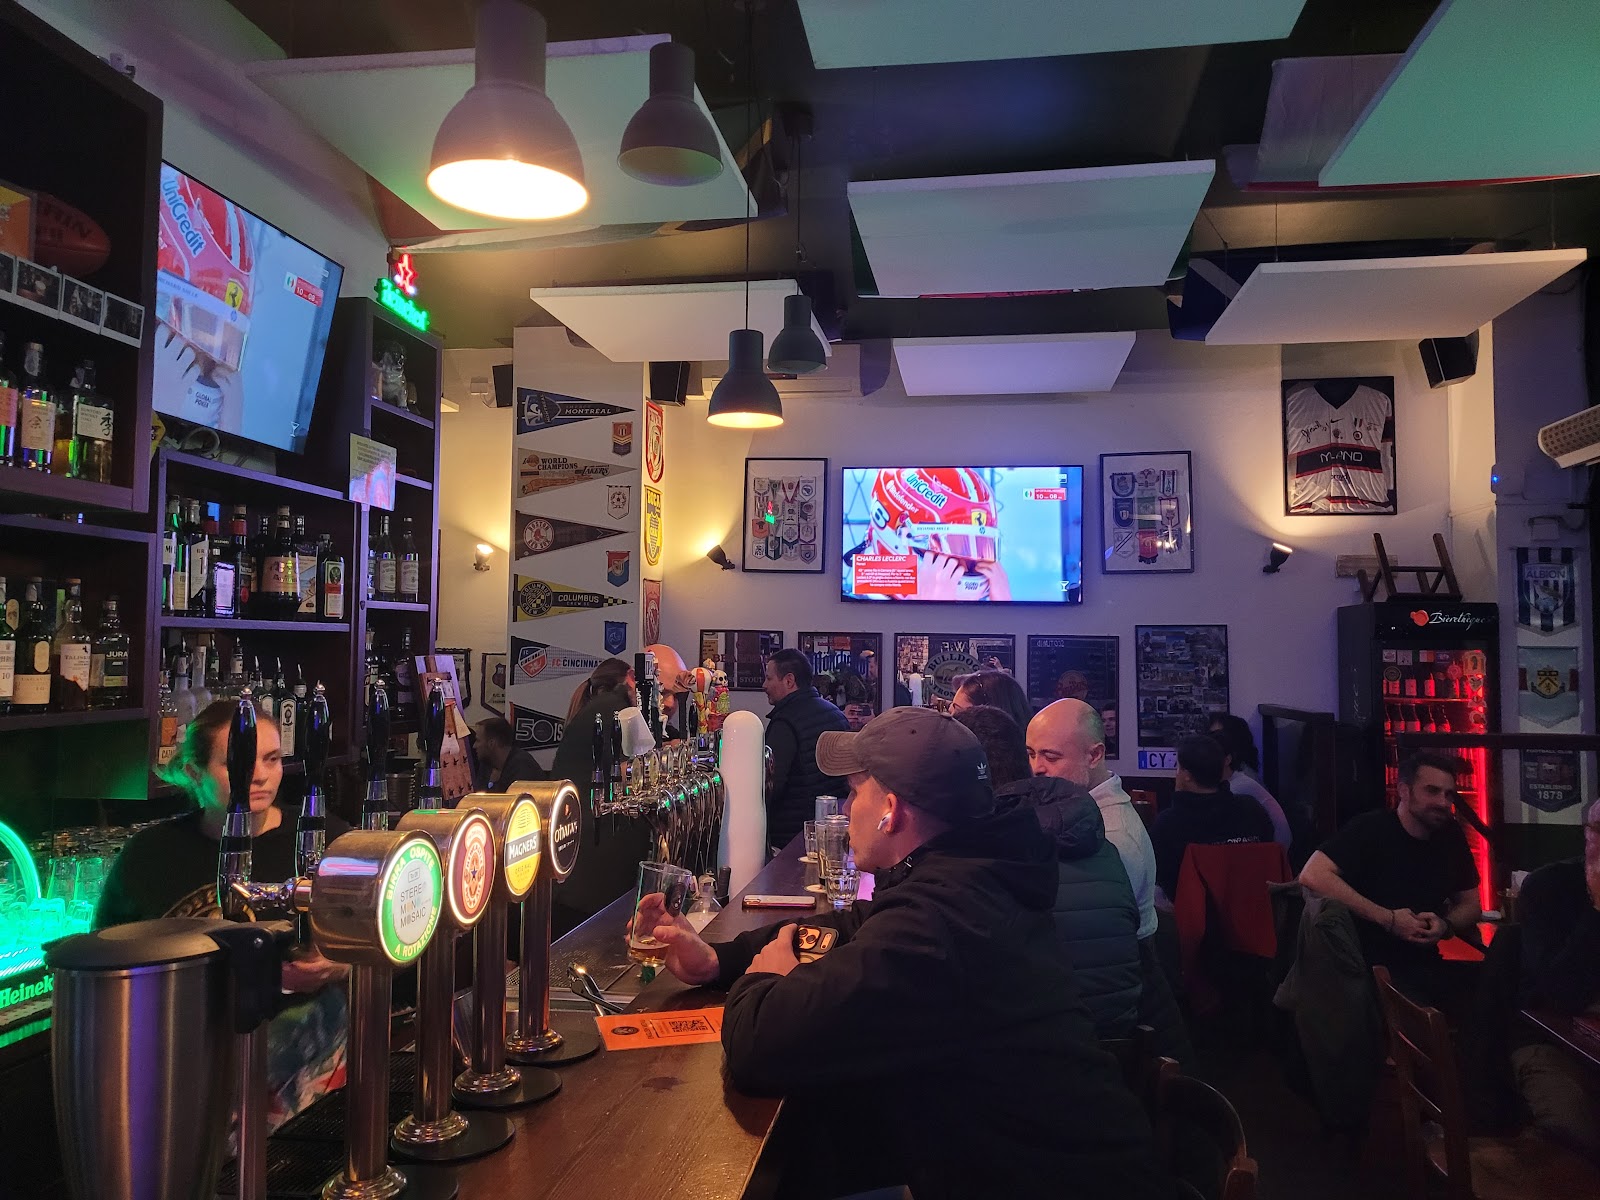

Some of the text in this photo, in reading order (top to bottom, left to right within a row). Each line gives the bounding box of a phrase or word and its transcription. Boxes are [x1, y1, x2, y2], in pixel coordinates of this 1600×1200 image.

[162, 180, 206, 257] UniCredit
[541, 457, 568, 465] WORLD
[1320, 451, 1363, 463] MANO
[537, 463, 578, 471] CHAMPIONS
[906, 474, 947, 508] UniCredit
[528, 519, 550, 531] BOSTON
[1525, 570, 1566, 579] ALBION
[522, 582, 550, 597] COLUMBUS
[558, 594, 600, 603] COLUMBUS
[106, 650, 129, 659] JURA
[552, 659, 560, 667] FC
[928, 653, 981, 673] BULLDOG
[1149, 753, 1167, 768] CY
[508, 834, 538, 860] MAGNERS
[385, 846, 435, 900] BIRRA OSPITE
[395, 906, 438, 957] A ROTAZIONE
